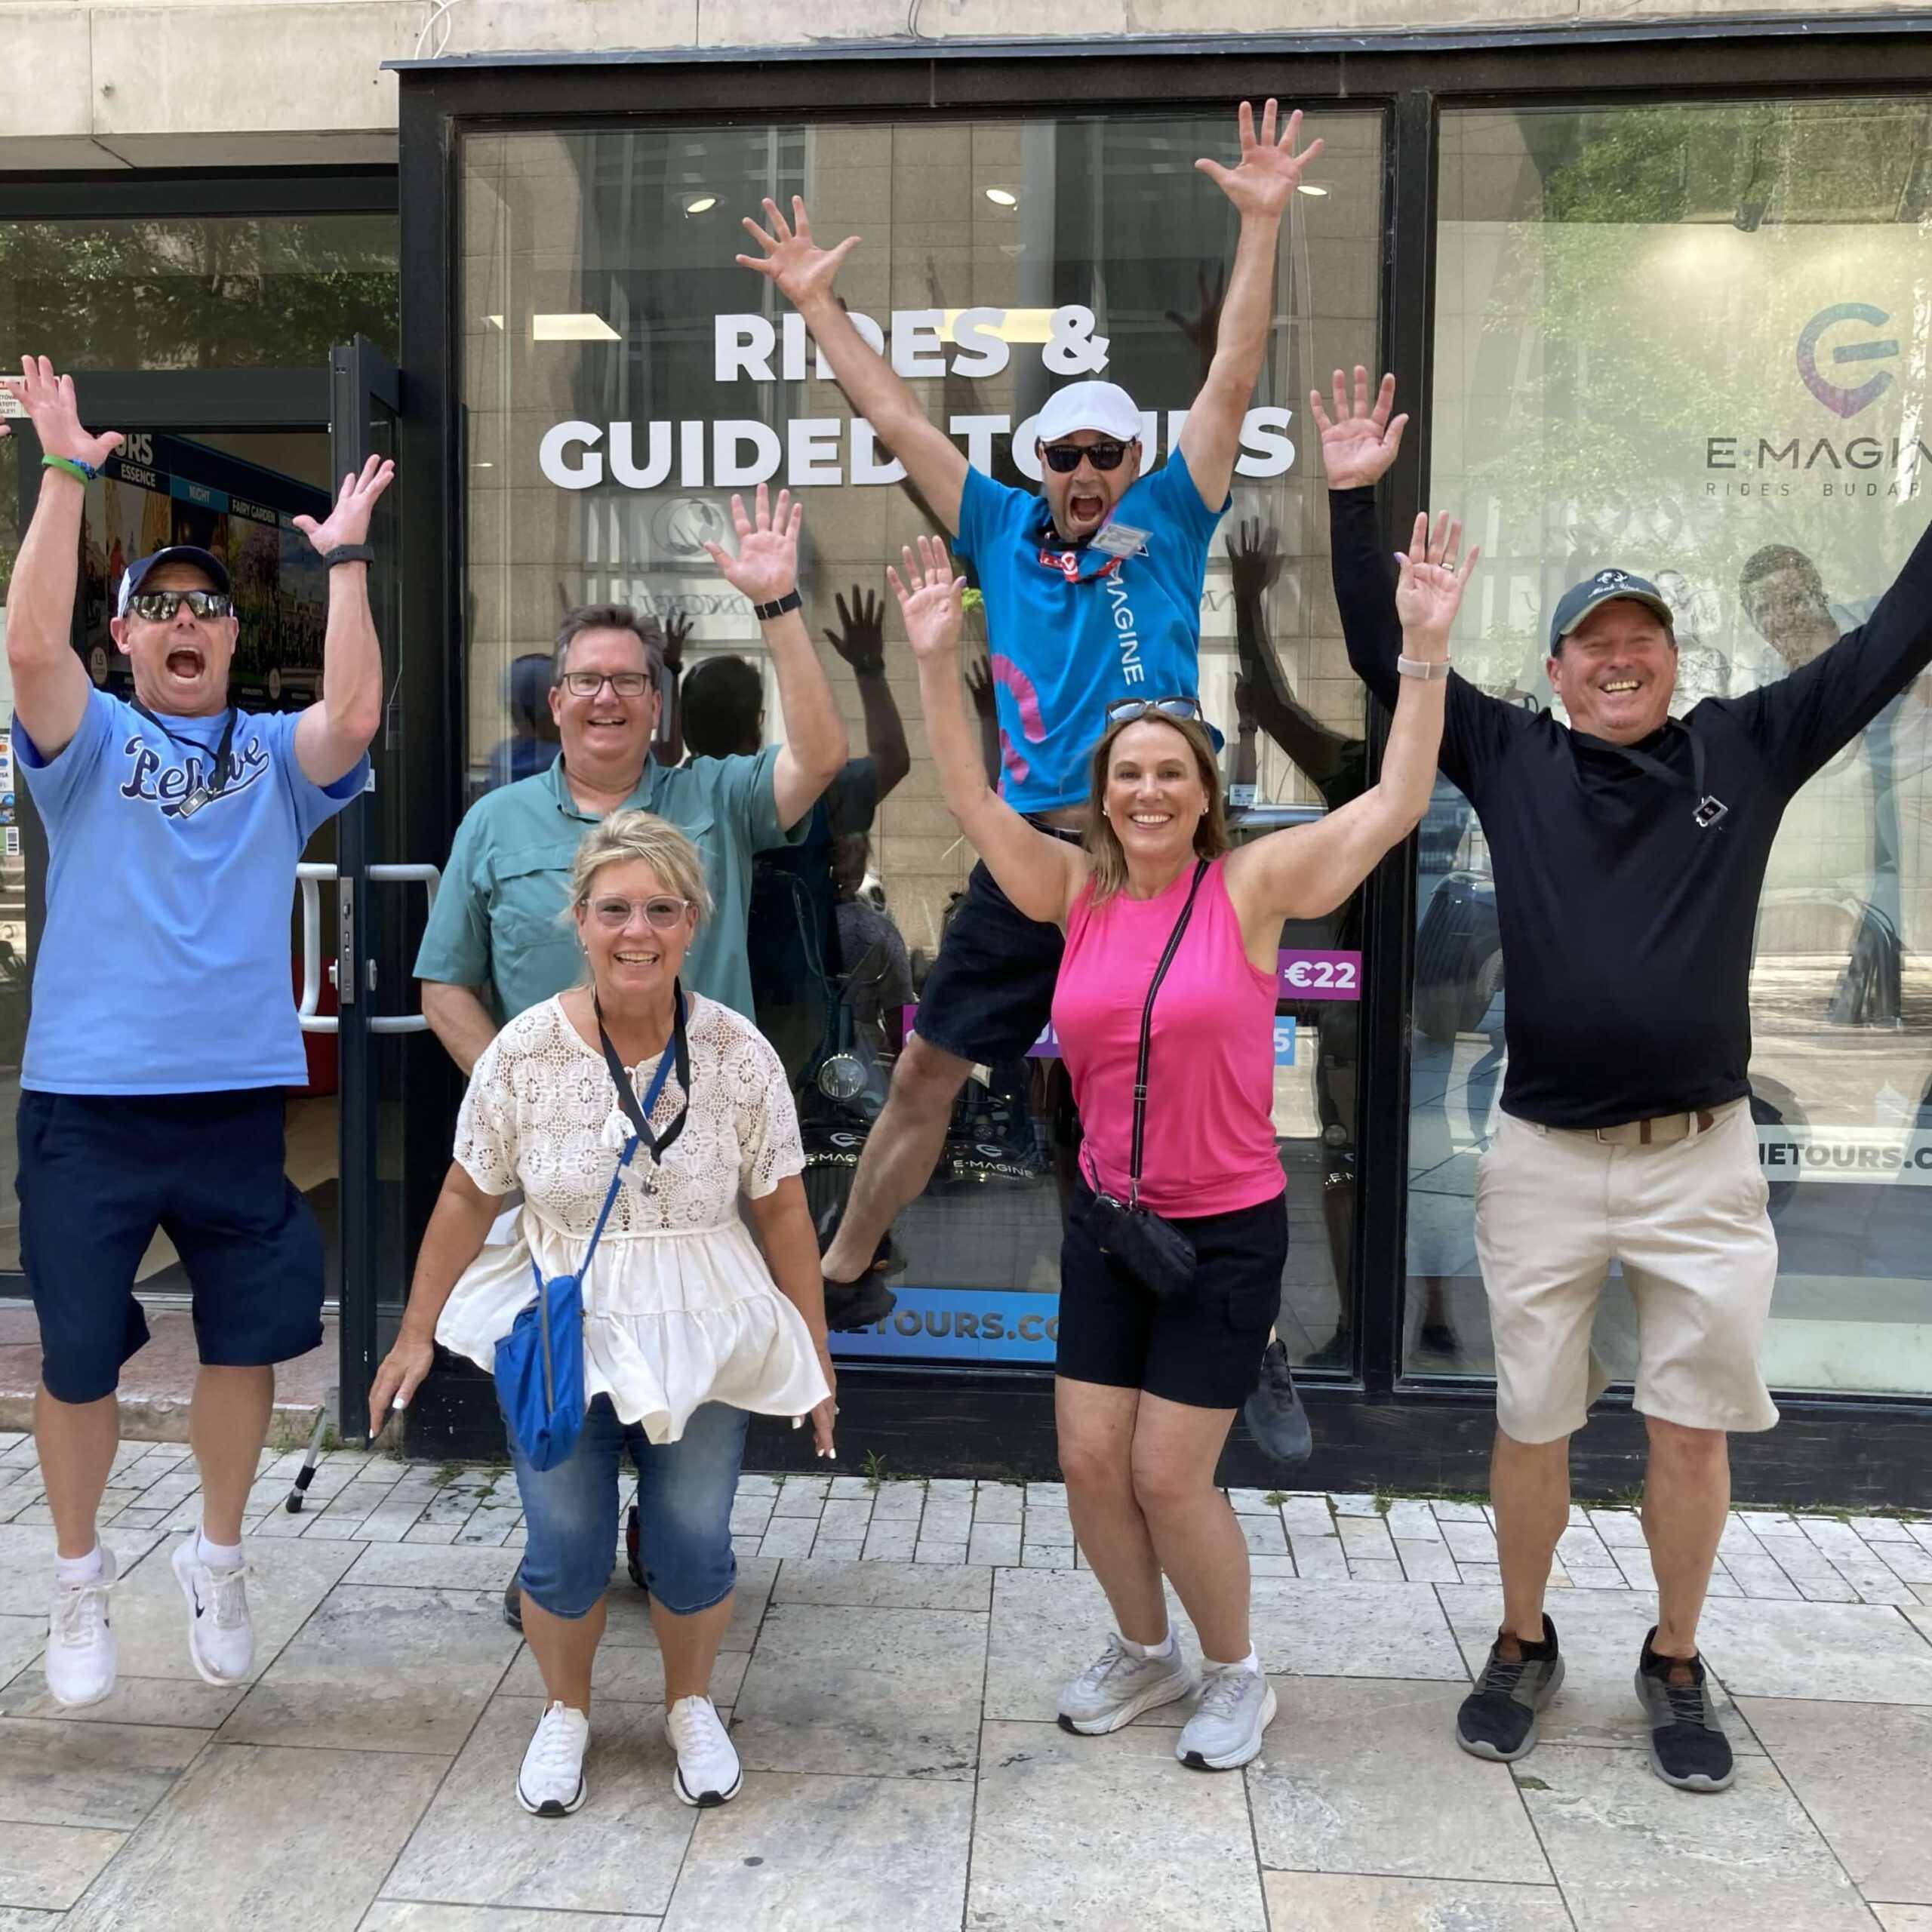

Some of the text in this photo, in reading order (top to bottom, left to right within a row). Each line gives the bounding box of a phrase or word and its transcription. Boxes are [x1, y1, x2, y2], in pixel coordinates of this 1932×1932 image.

[1041, 304, 1110, 375] &
[539, 418, 907, 489] GUIDED
[121, 464, 155, 488] ESSENCE
[189, 485, 211, 503] NIGHT
[1706, 483, 1932, 496] RIDES BUDAP
[232, 499, 251, 515] FAIRY
[251, 505, 275, 524] GARDEN
[121, 736, 269, 801] Belive
[1284, 961, 1356, 988] €22
